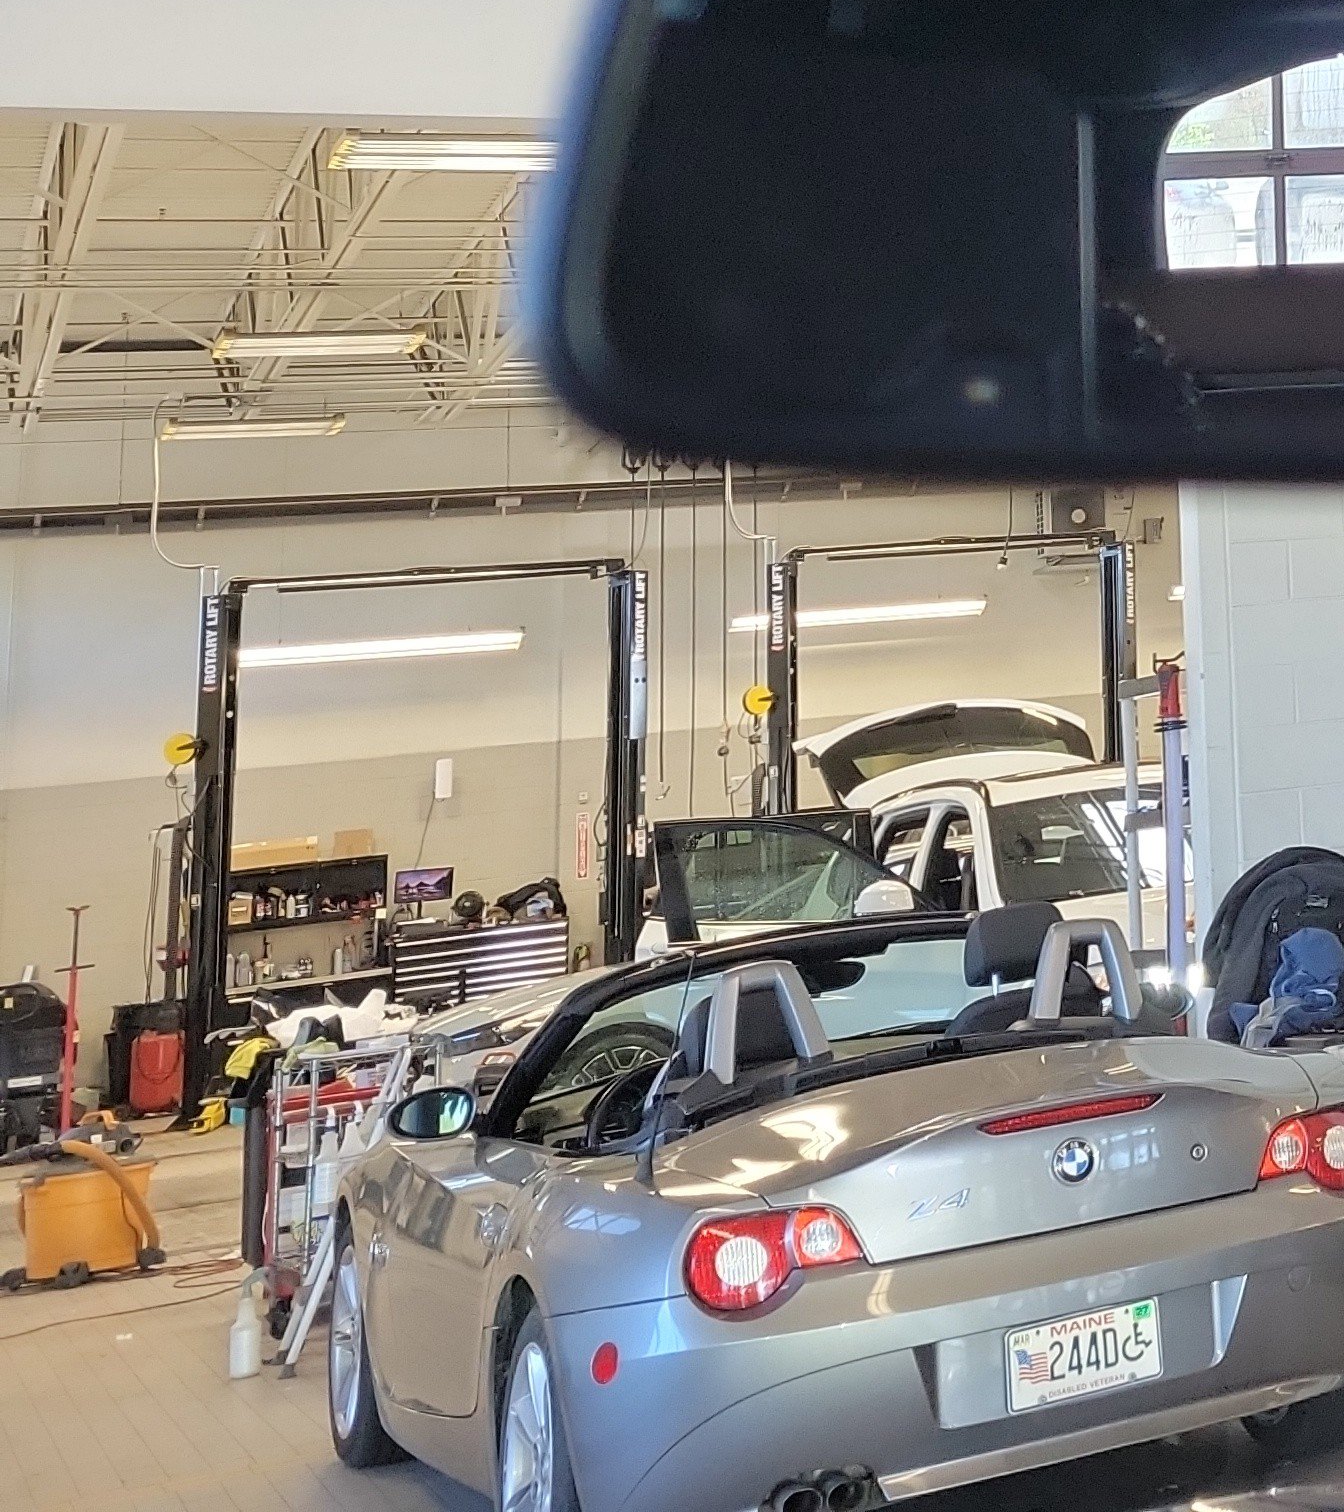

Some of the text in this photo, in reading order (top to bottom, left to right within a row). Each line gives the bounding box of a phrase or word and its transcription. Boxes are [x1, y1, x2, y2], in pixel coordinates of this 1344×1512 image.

[635, 572, 646, 653] ROTARY LIFT
[772, 564, 783, 645] ROTARY LIFT
[1126, 571, 1134, 617] ROTARY
[204, 596, 219, 685] ROTARY LIFT
[908, 1188, 970, 1221] Z4
[1050, 1312, 1115, 1338] MAINE
[1135, 1305, 1149, 1316] 27
[1049, 1327, 1119, 1381] 244D
[1048, 1374, 1126, 1399] DISABLED VETERAN
